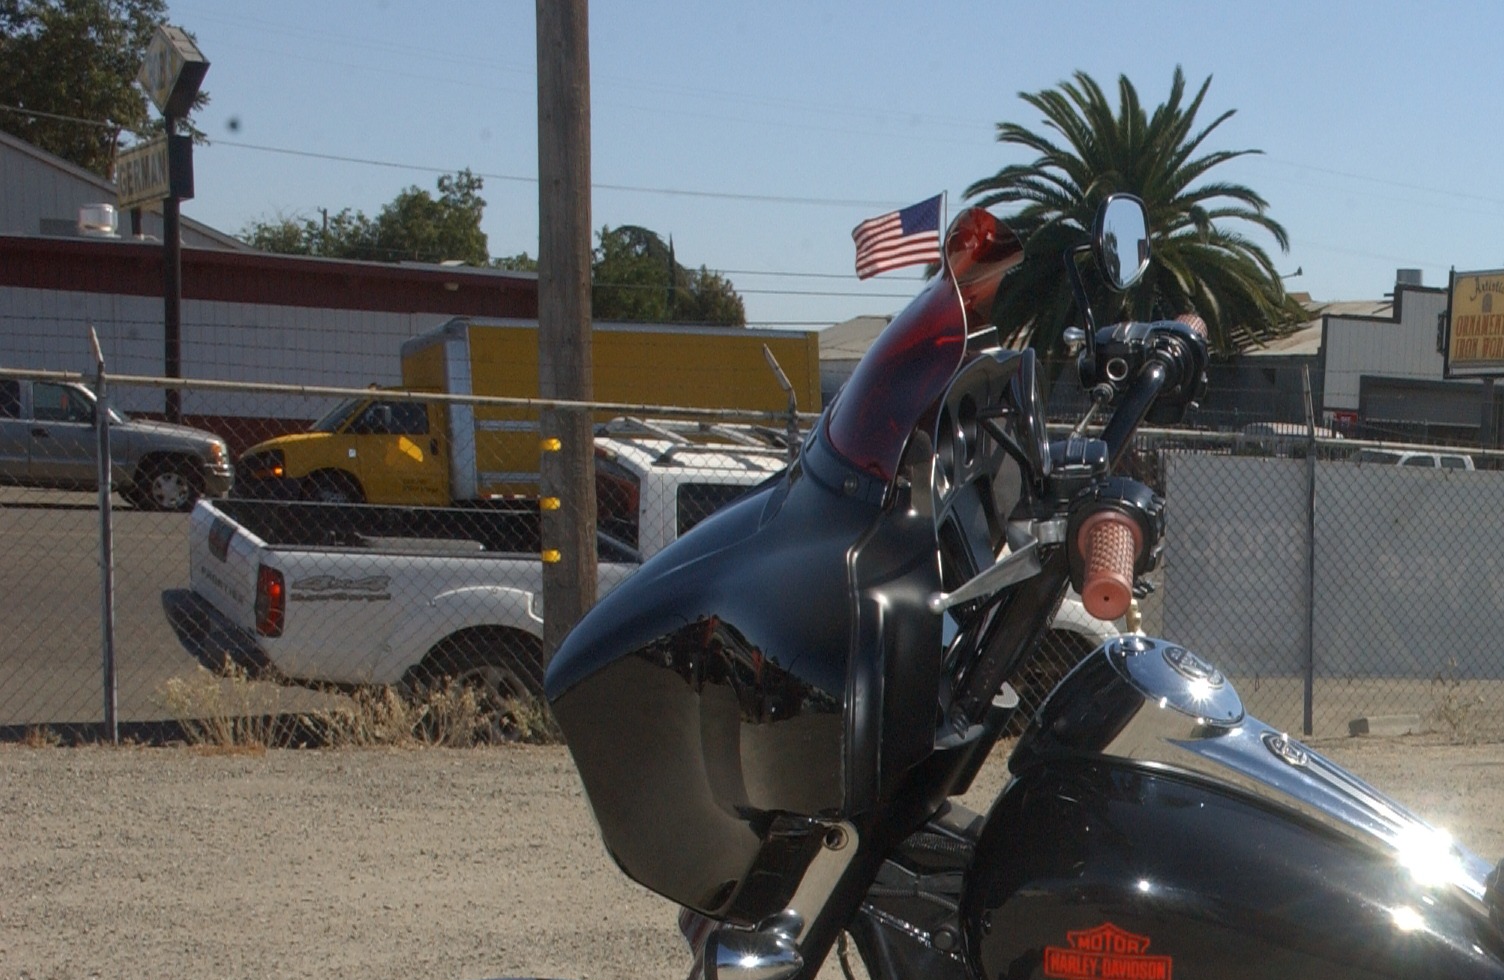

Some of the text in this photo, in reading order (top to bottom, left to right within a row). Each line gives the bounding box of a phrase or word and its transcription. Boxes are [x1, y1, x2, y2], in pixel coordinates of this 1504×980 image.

[119, 150, 167, 197] GERMAN
[1454, 338, 1479, 359] IRON
[1078, 931, 1139, 953] MOTOR
